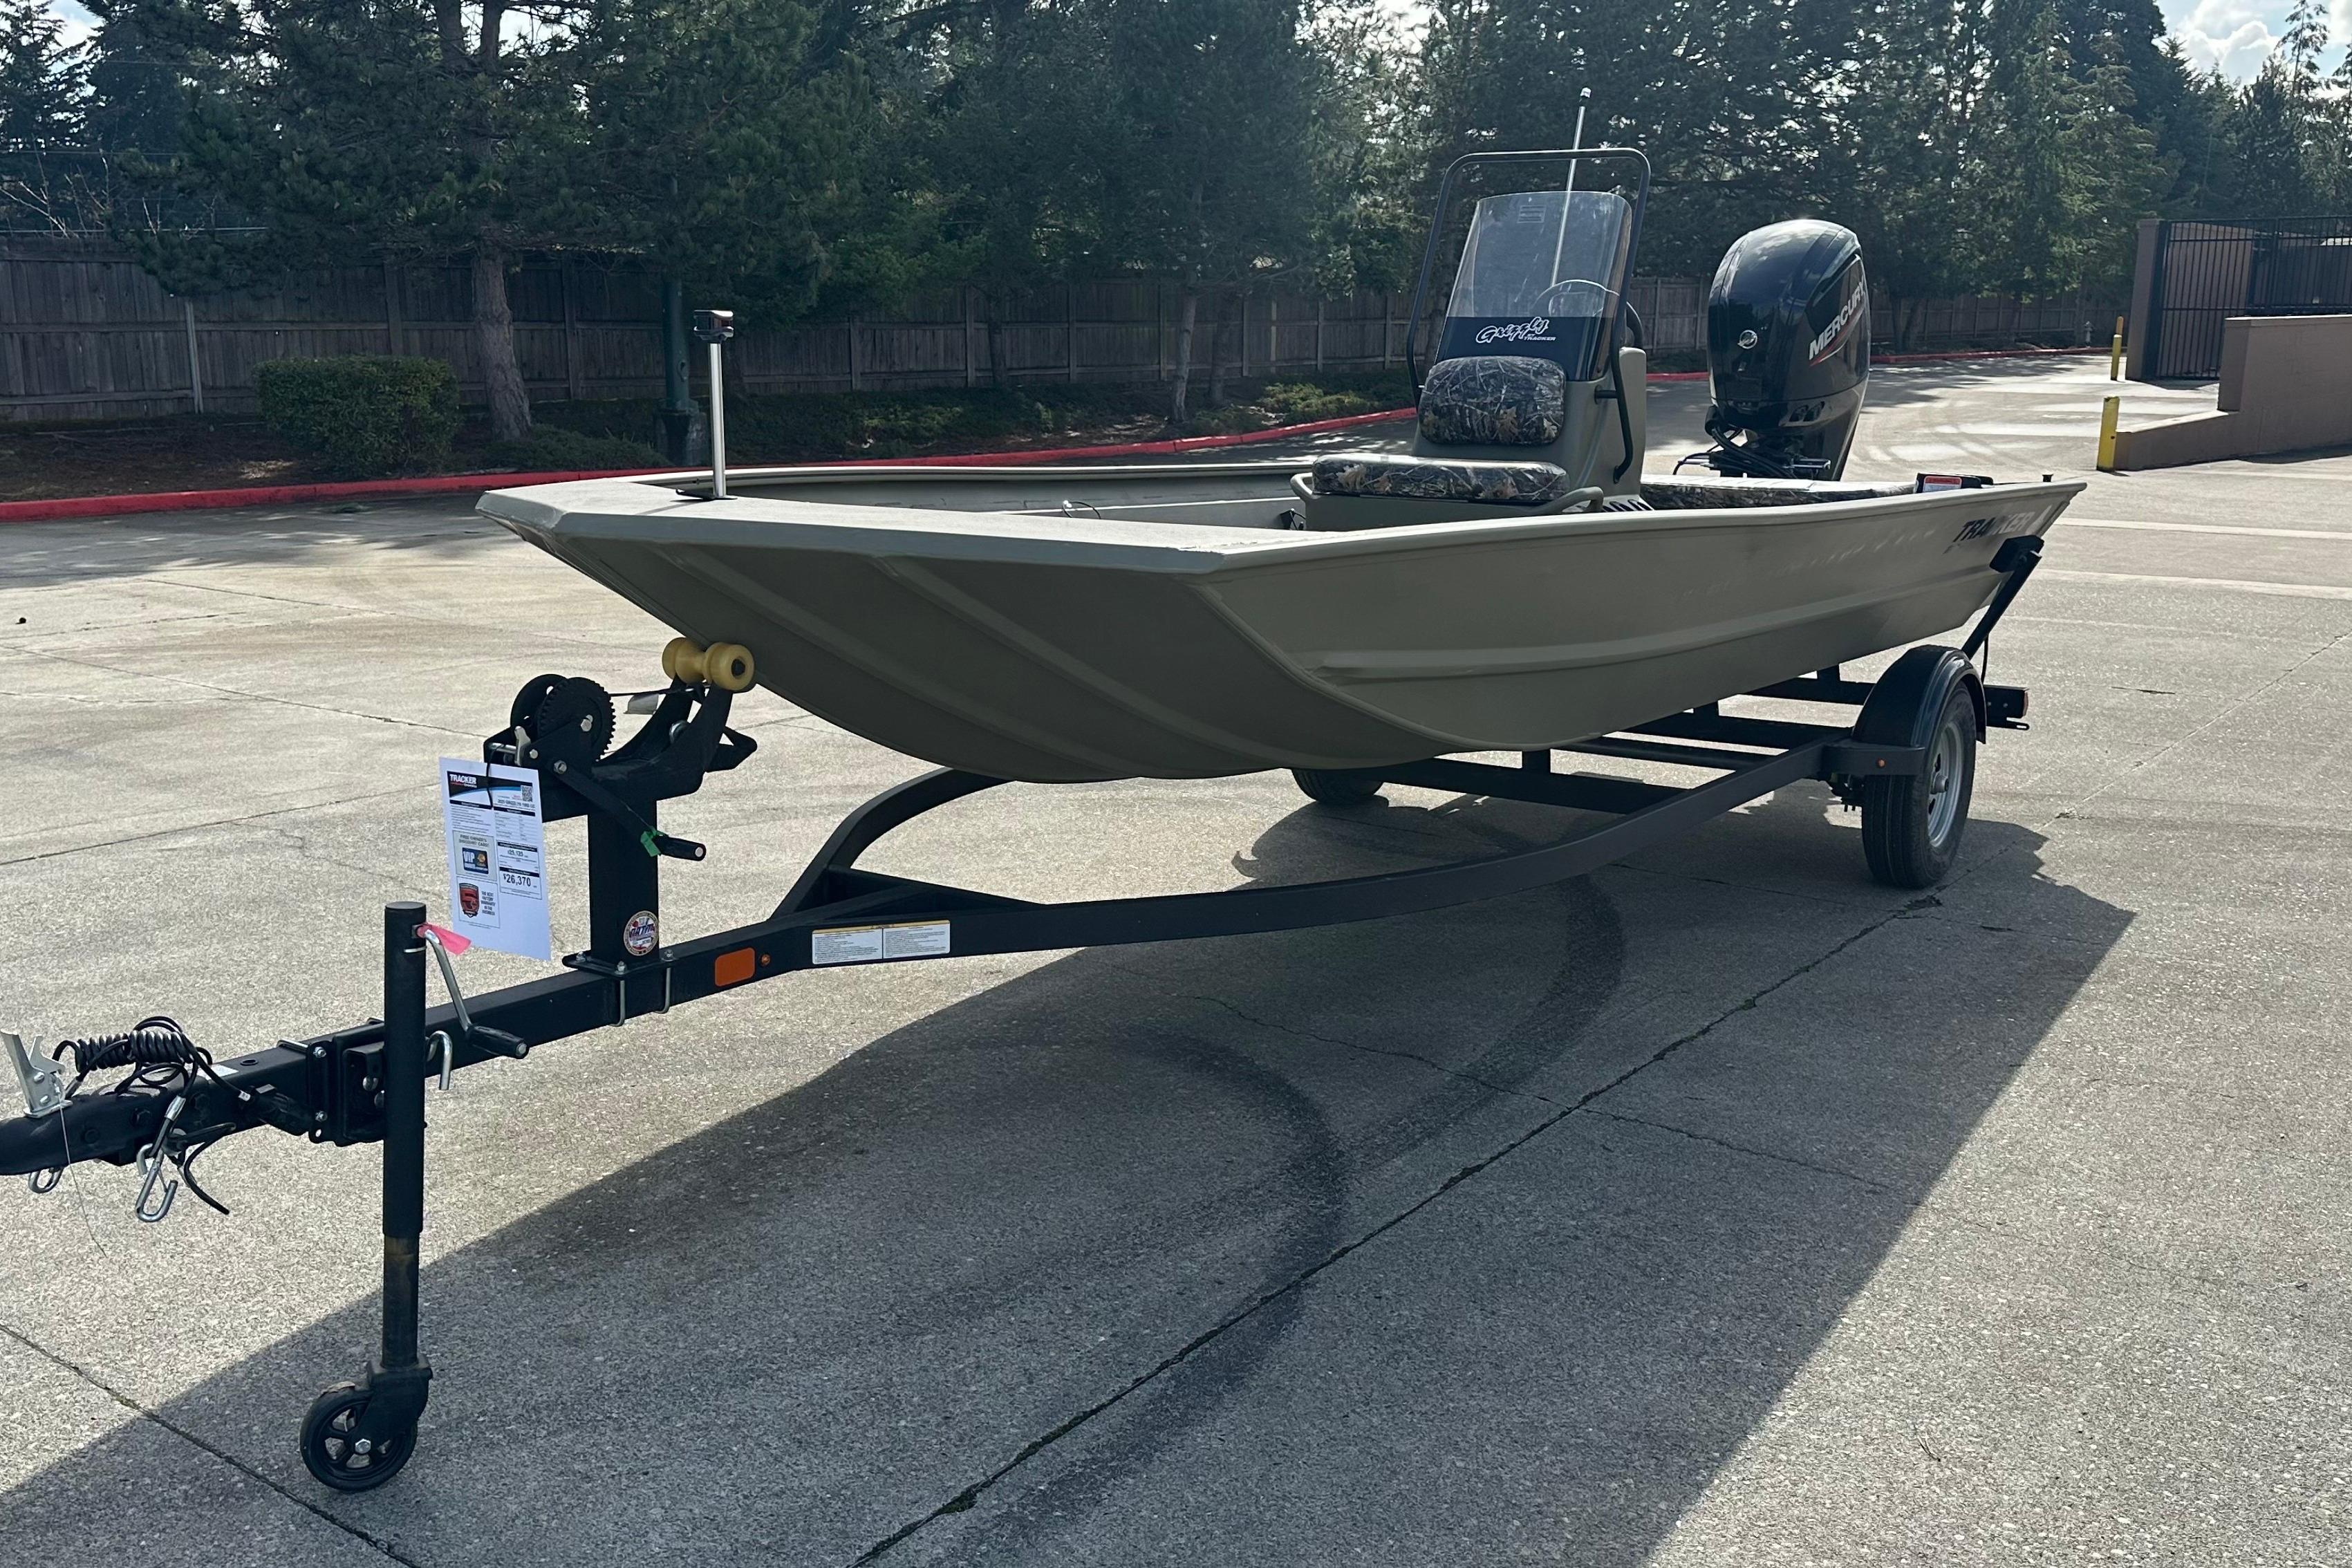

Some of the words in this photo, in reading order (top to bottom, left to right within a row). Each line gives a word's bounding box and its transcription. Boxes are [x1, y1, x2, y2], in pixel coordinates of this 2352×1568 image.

[1809, 274, 1865, 360] MERCURY
[1475, 316, 1549, 344] Grizzly
[449, 774, 477, 785] TRACKER
[463, 850, 476, 863] VIP
[503, 872, 532, 887] $26,370
